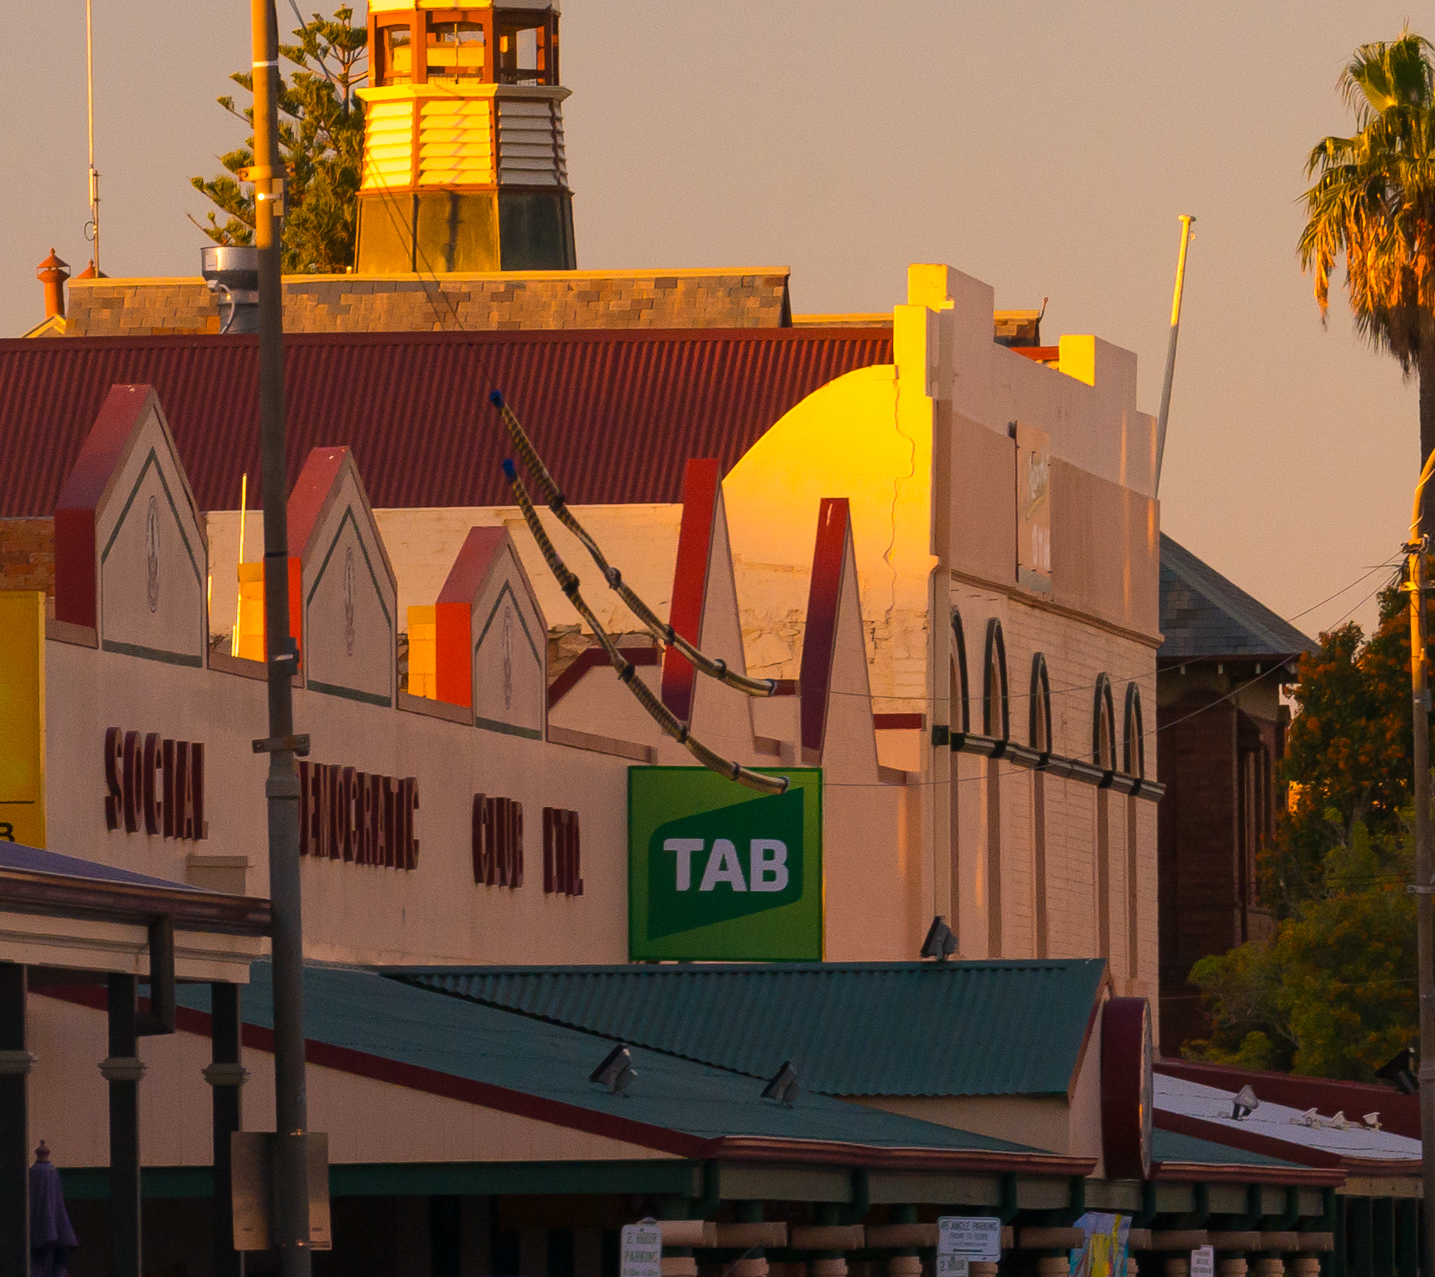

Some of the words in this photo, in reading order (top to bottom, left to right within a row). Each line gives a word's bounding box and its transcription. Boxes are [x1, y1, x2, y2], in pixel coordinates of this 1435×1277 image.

[104, 727, 209, 841] SOCIAL
[293, 759, 420, 870] EMOCRATIC
[472, 793, 524, 888] CLUB
[663, 838, 790, 892] TAB
